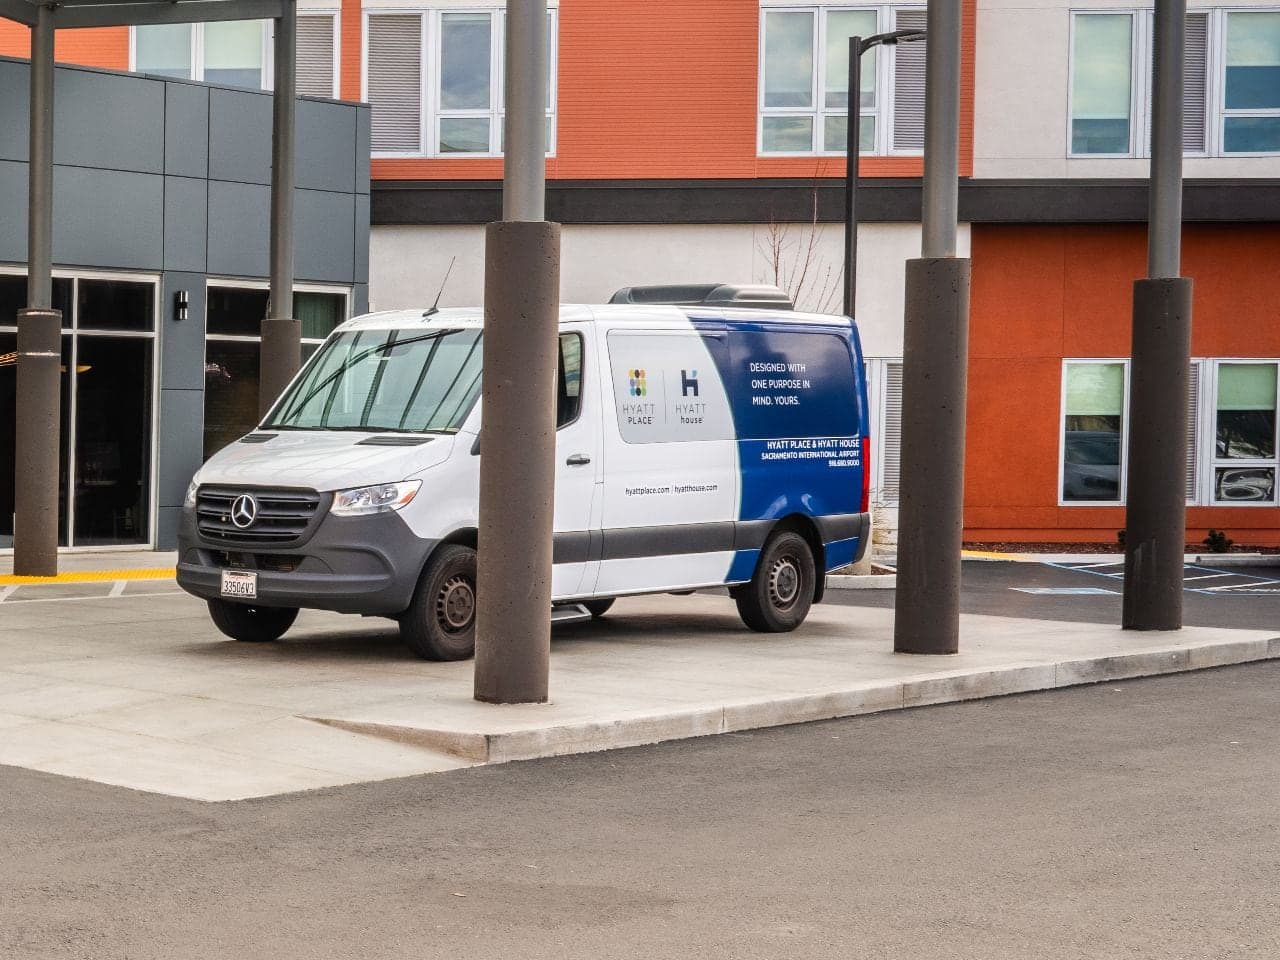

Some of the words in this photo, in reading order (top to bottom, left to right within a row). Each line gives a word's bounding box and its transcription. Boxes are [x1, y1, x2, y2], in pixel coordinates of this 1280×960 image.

[750, 362, 786, 373] DESIGNED
[787, 363, 806, 373] WITH
[751, 379, 768, 389] ONE
[768, 379, 801, 389] PURPOSE
[802, 380, 811, 389] IN
[752, 396, 774, 406] MIND.
[774, 396, 801, 406] YOURS.
[622, 403, 656, 415] HYATT
[675, 403, 707, 415] HYATT
[627, 416, 653, 425] PLACE
[680, 415, 704, 424] house
[767, 441, 789, 450] HYATT
[790, 440, 811, 449] PLACE
[812, 440, 817, 449] &
[818, 440, 839, 448] HYATT
[839, 439, 860, 448] HOUSE
[761, 452, 798, 460] SACRAMENTO
[798, 450, 838, 459] INTERNATIONAL
[837, 450, 859, 458] AIRPORT
[625, 487, 670, 496] hyattplace.com
[674, 485, 718, 494] hyatthouse.com
